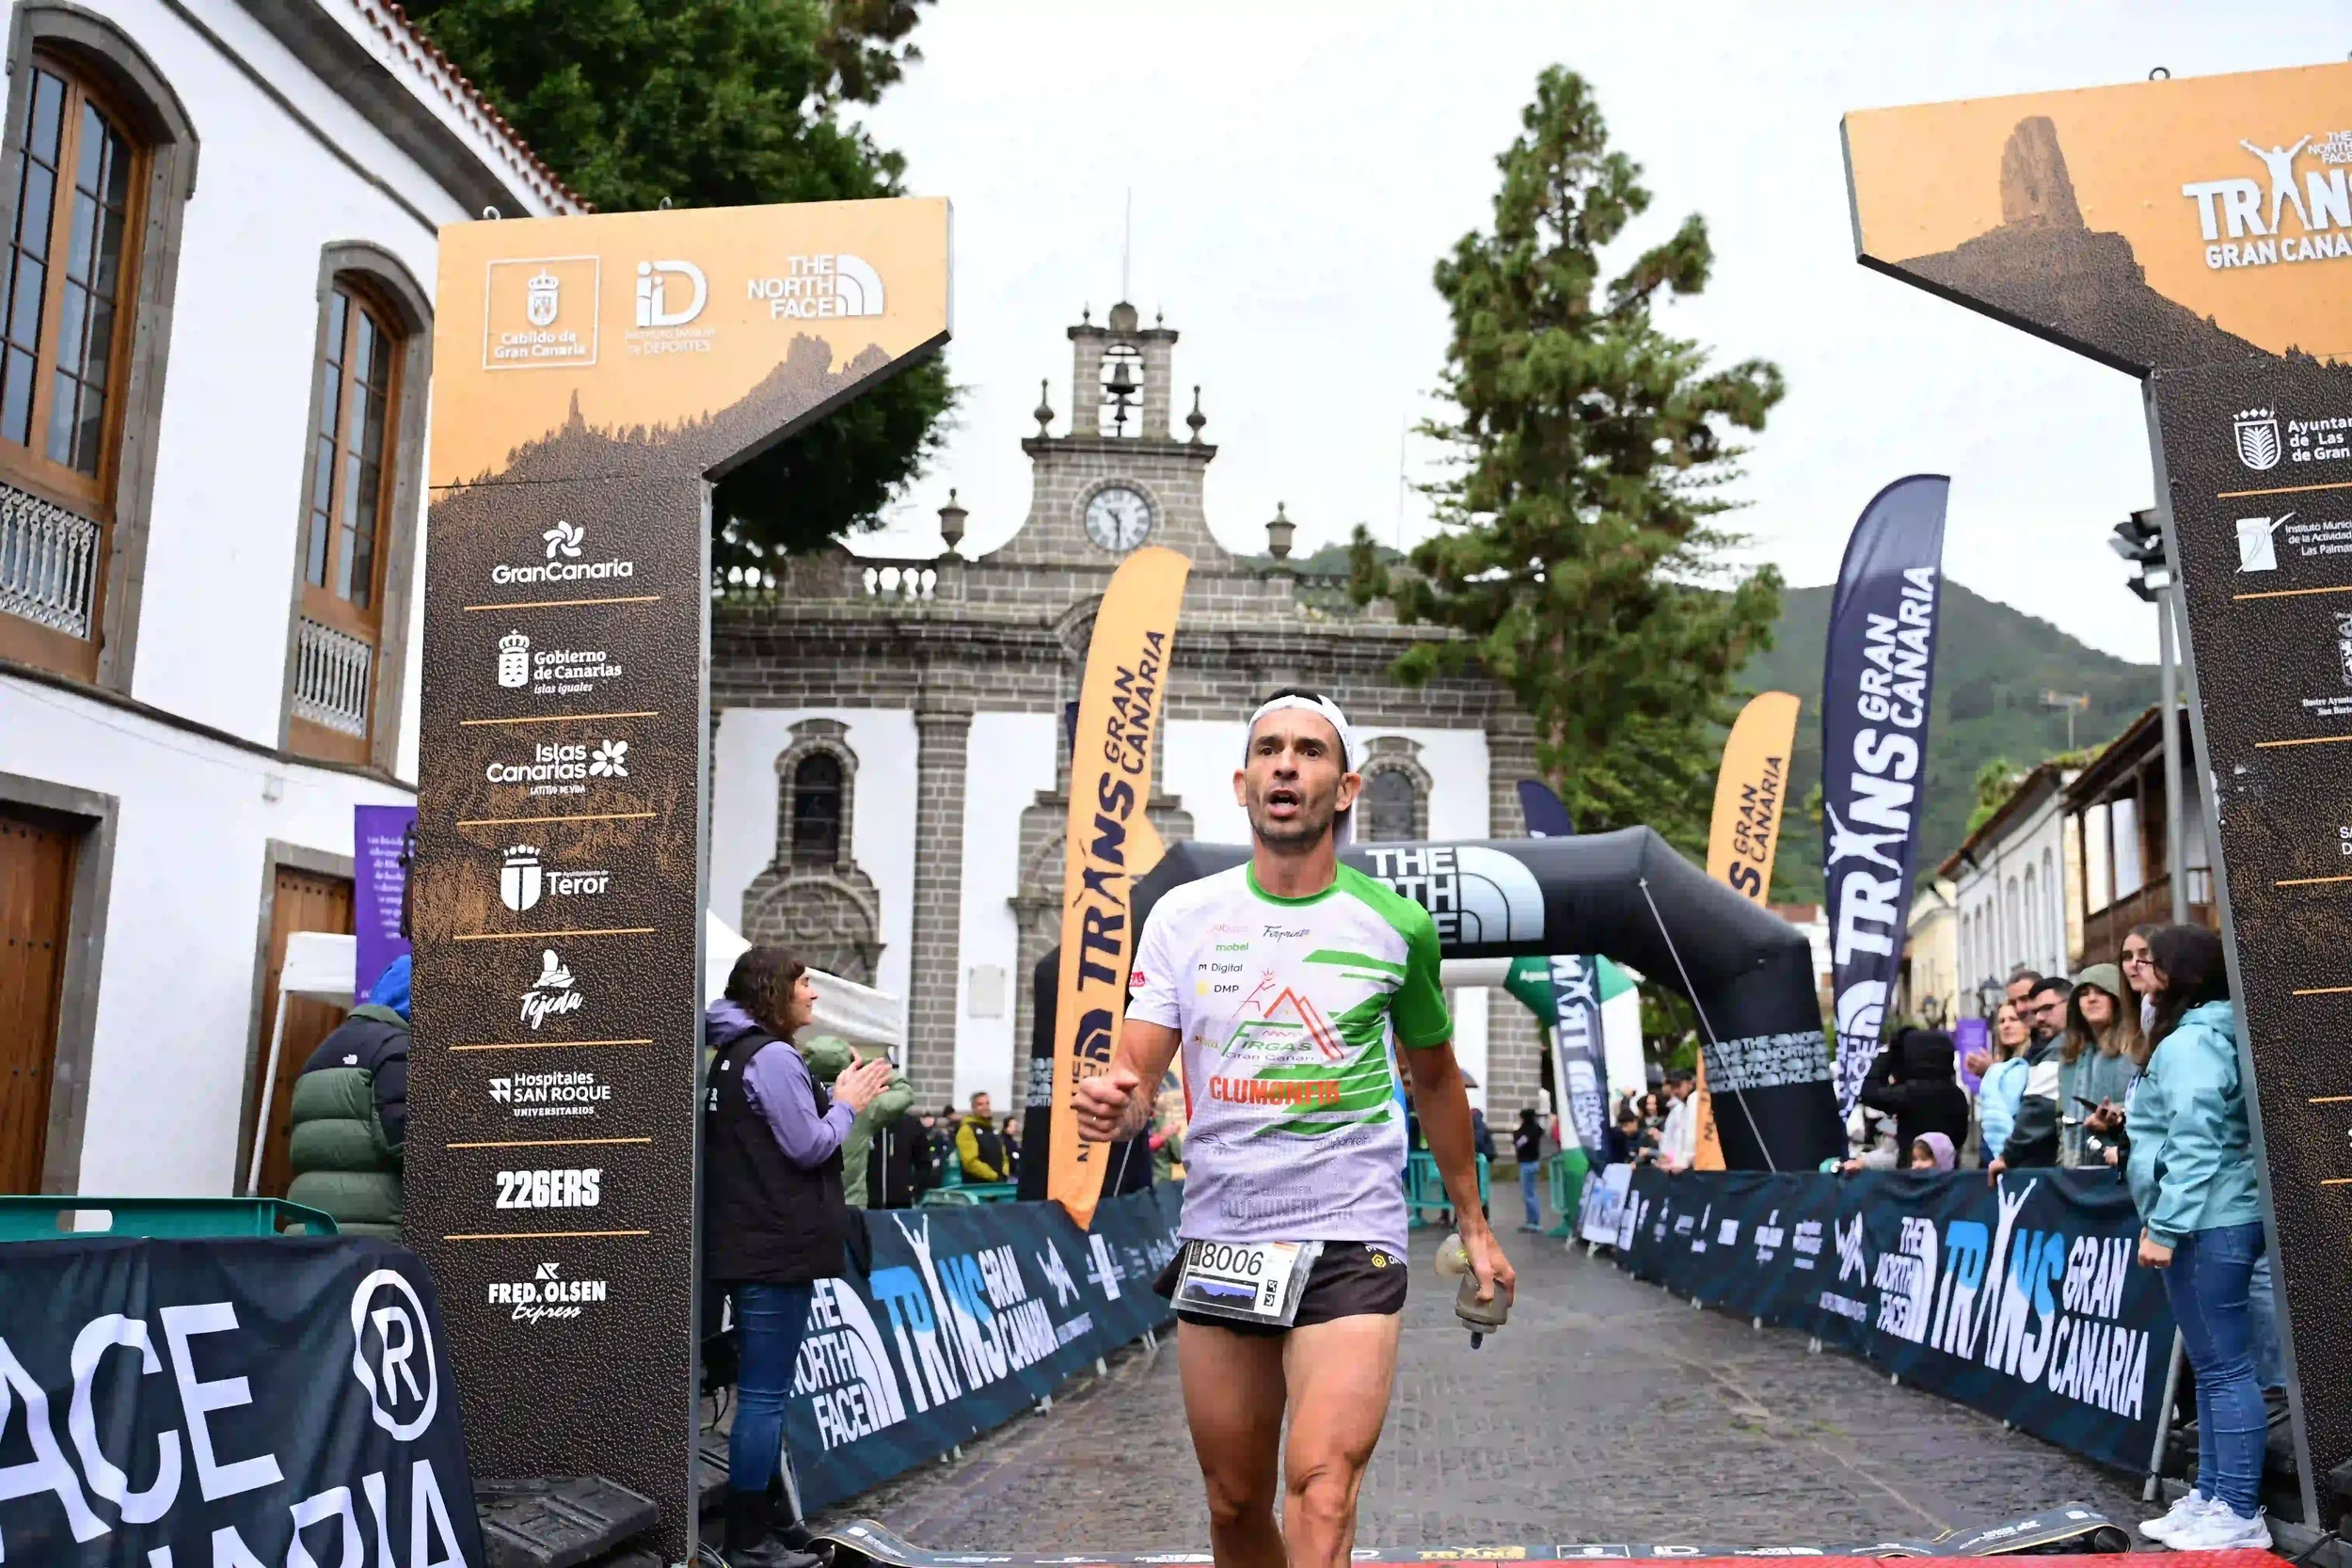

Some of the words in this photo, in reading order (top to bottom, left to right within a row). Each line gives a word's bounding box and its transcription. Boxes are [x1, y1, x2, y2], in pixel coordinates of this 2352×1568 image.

[2182, 135, 2352, 241] TRAN
[787, 254, 835, 277] THE
[2205, 239, 2278, 269] GRAN
[747, 275, 835, 299] NORTH
[771, 295, 834, 320] FACE
[494, 346, 529, 359] Gran
[531, 342, 586, 358] Canaria
[501, 330, 556, 345] Cabildo
[559, 329, 577, 342] de
[2289, 433, 2310, 448] de
[2317, 432, 2344, 446] Las
[2292, 448, 2312, 462] de
[2313, 447, 2351, 460] Gran
[2285, 522, 2322, 534] Instituto
[2288, 534, 2300, 545] de
[2302, 533, 2311, 543] la
[2312, 530, 2352, 543] Actividad
[2301, 546, 2318, 556] Las
[491, 559, 633, 584] GranCanaria
[533, 650, 607, 665] Gobierno
[1889, 566, 1935, 728] CANARIA
[533, 667, 552, 680] de
[554, 664, 622, 679] Canarias
[1856, 612, 1899, 722] GRAN
[533, 684, 556, 694] islas
[558, 682, 593, 695] iguales
[1104, 665, 1136, 764] GRAN
[1120, 630, 1166, 775] CANARIA
[535, 742, 587, 762] Islas
[485, 758, 587, 783] Canarias
[1733, 782, 1757, 854] GRAN
[1749, 756, 1782, 863] CANARIA
[1823, 727, 1920, 966] TRANS
[1365, 847, 1456, 877] THE
[546, 871, 609, 895] Teror
[1073, 771, 1136, 992] TRANS
[1211, 963, 1244, 974] Digital
[1214, 984, 1240, 993] DMP
[520, 990, 584, 1030] Tejeda
[514, 1071, 595, 1090] Hospitales
[514, 1087, 548, 1103] SAN
[550, 1085, 612, 1101] ROQUE
[514, 1106, 595, 1117] UNIVERSITARIOS
[496, 1168, 600, 1210] 226ERS
[1899, 1215, 1925, 1256] THE
[1201, 1242, 1264, 1276] 8006
[977, 1243, 1027, 1309] GRAN
[1872, 1252, 1915, 1296] NORTH
[1931, 1174, 2066, 1385] TRANS
[2062, 1235, 2133, 1320] GRAN
[511, 1300, 582, 1325] Express
[806, 1277, 842, 1332] HE
[869, 1212, 1009, 1413] TRANS
[2047, 1315, 2150, 1422] CANARIA
[811, 1382, 873, 1451] FACE
